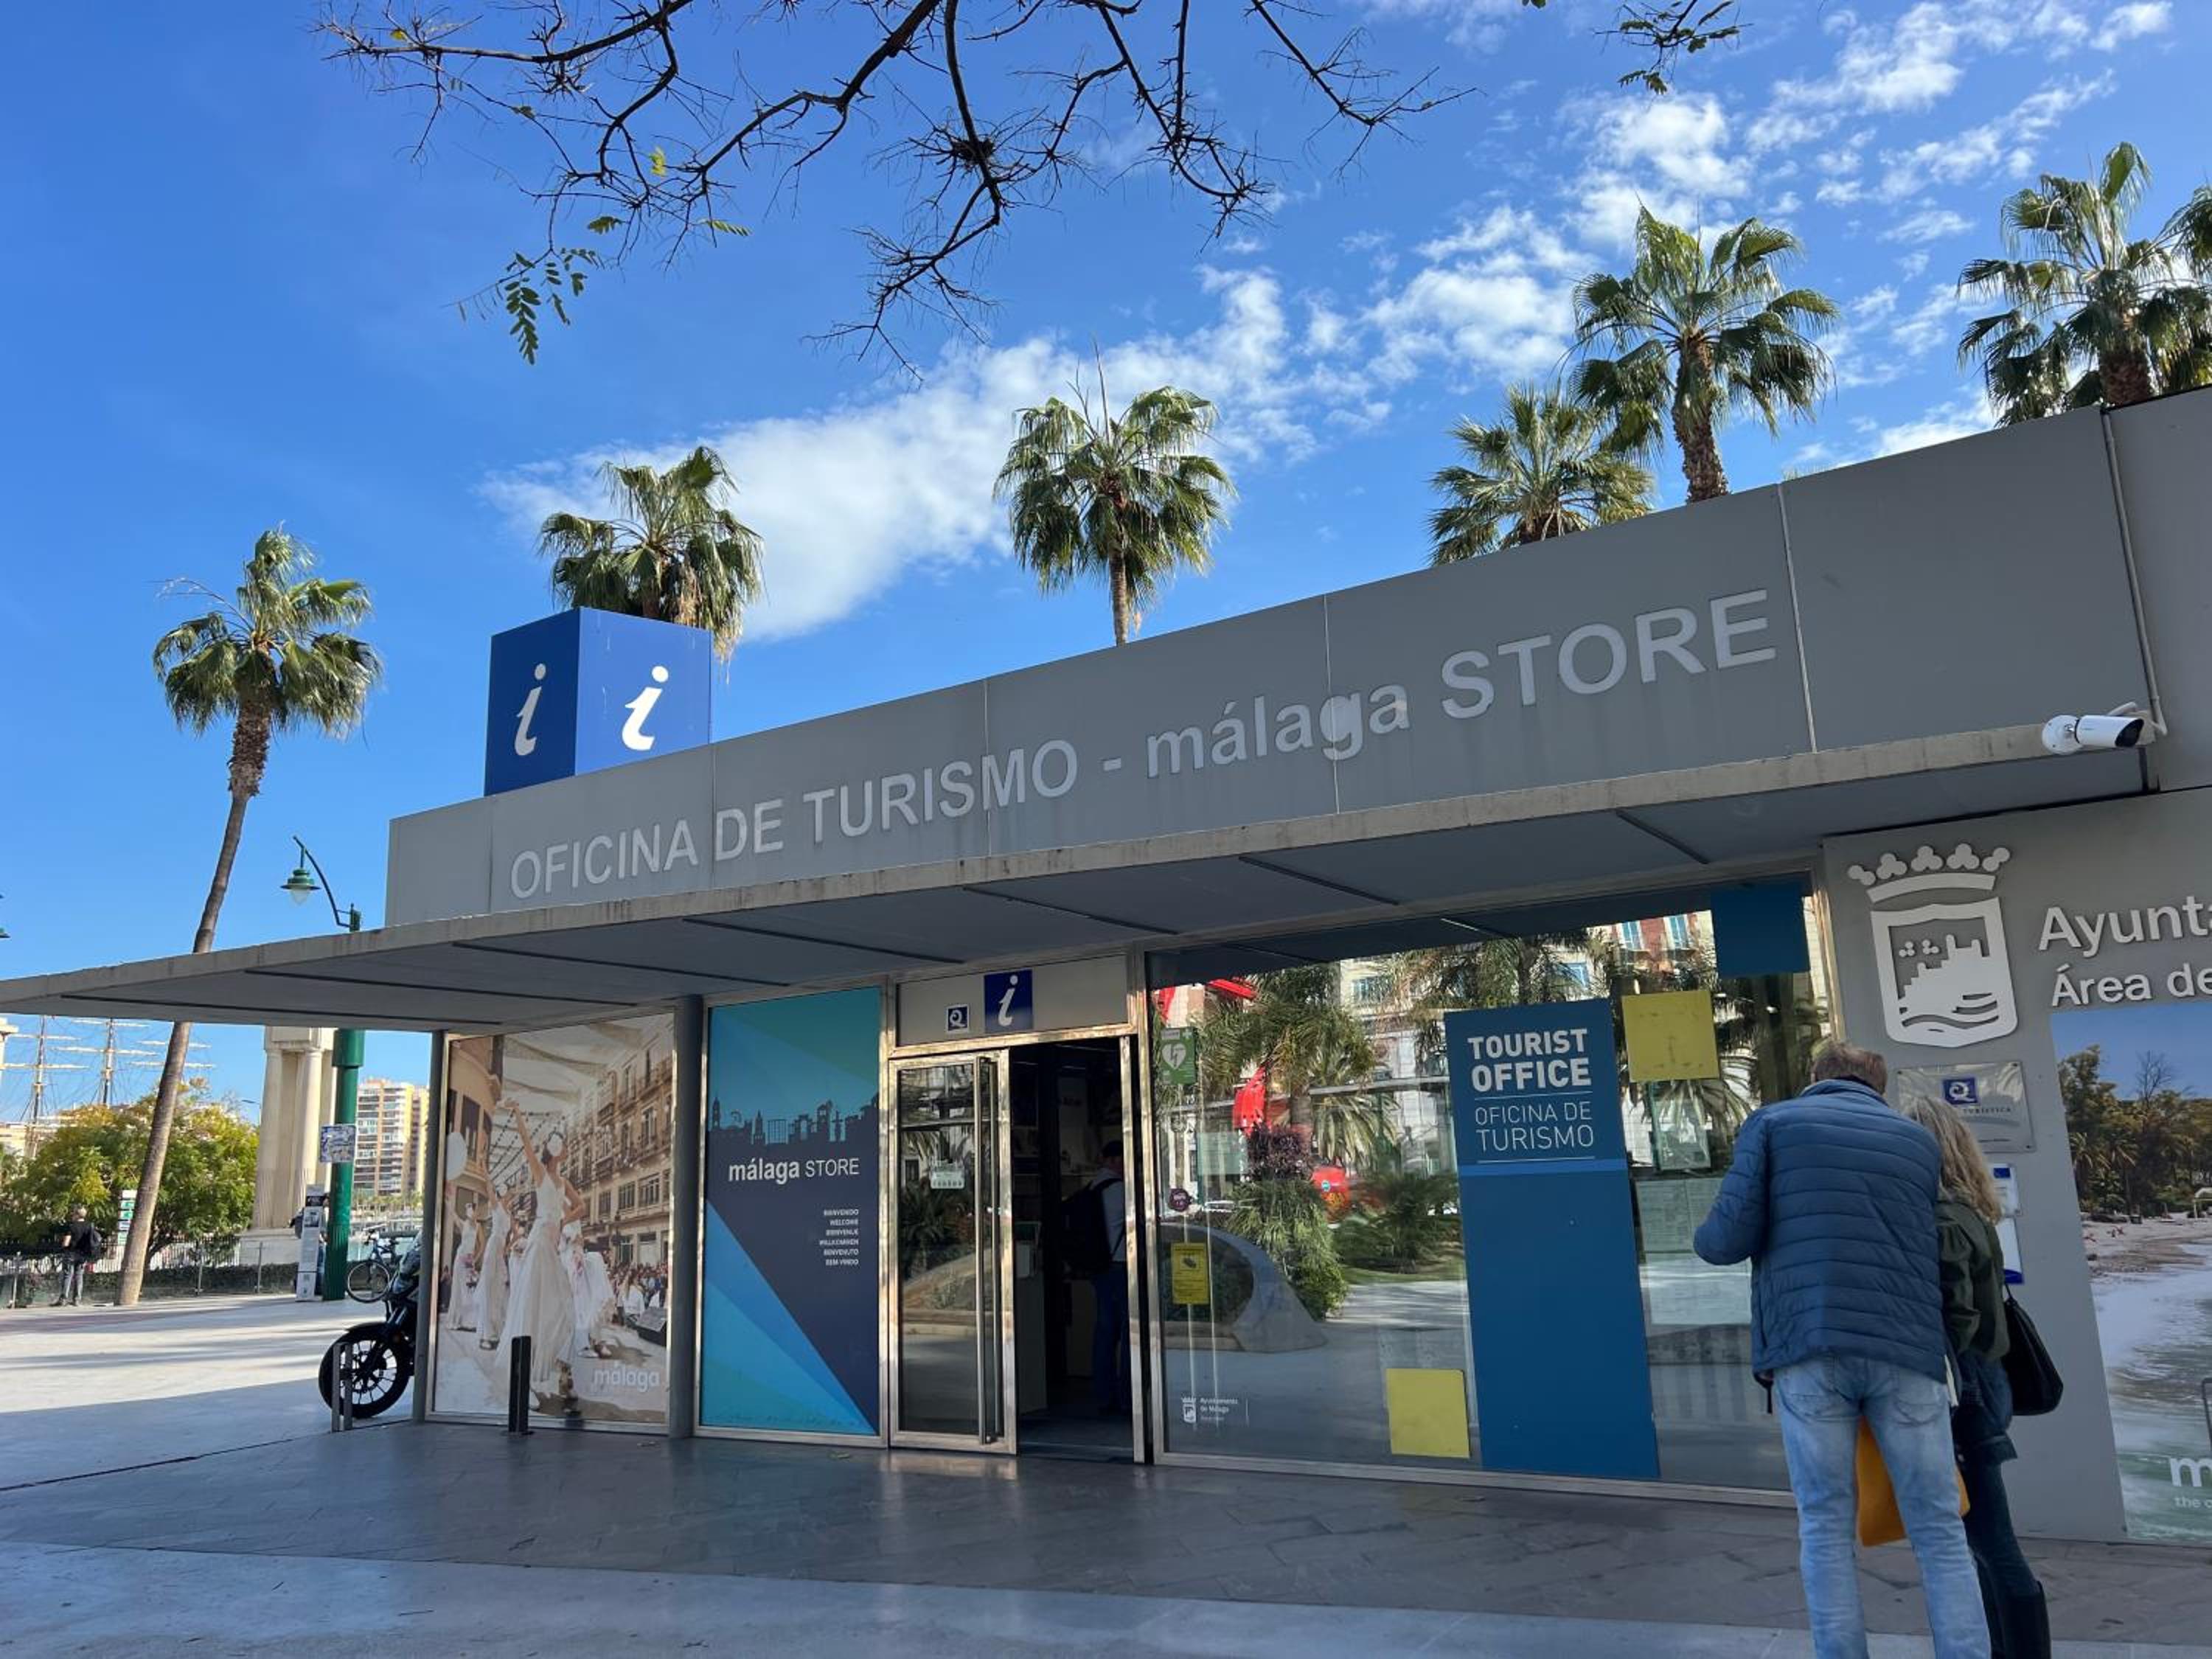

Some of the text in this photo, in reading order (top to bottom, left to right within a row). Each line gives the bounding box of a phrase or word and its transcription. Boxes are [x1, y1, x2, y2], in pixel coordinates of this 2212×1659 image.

[511, 819, 699, 899] OFICINA
[714, 799, 784, 861] DE
[802, 739, 1078, 844] TURISMO
[1147, 684, 1411, 779] málaga
[1441, 588, 1776, 720] STORE
[2038, 896, 2212, 958] Ayunt
[2052, 962, 2212, 1007] Área de
[1467, 1028, 1588, 1060] TOURIST
[1472, 1057, 1593, 1093] OFFICE
[1475, 1101, 1593, 1126] OFICINA DE
[1475, 1124, 1594, 1153] TURISMO
[728, 1158, 860, 1185] málaga STORE
[593, 1360, 661, 1393] málaga
